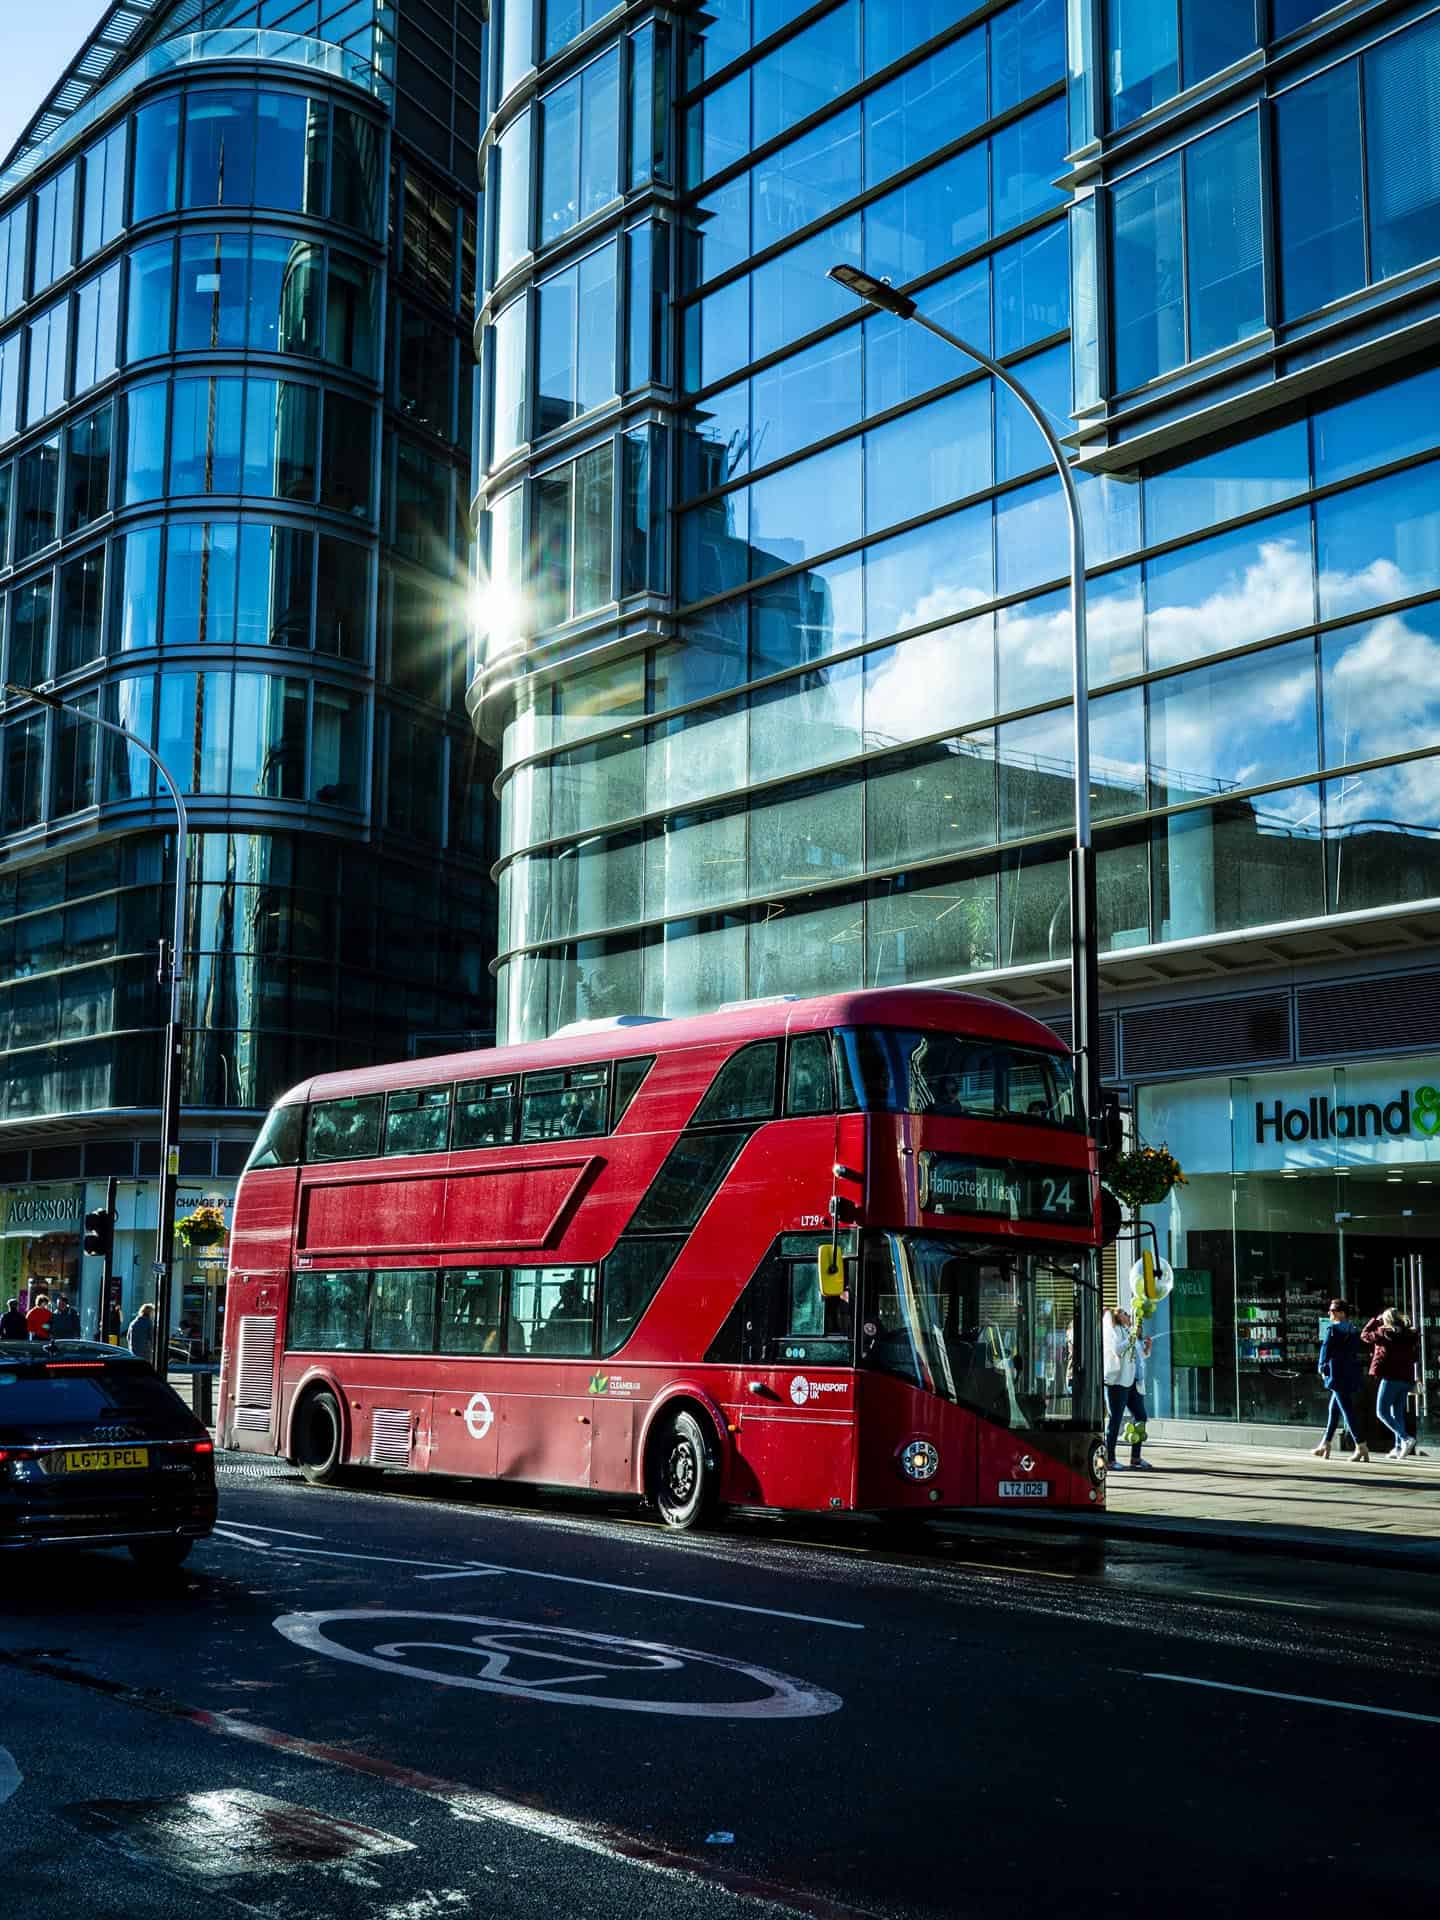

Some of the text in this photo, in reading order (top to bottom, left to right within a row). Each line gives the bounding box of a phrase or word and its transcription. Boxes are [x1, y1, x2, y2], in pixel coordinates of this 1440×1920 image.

[929, 1169, 988, 1200] Hampstead
[1042, 1178, 1074, 1213] 24
[218, 1198, 235, 1208] PLE
[8, 1198, 81, 1223] ACCESSORI
[809, 1382, 848, 1392] TRANSPORT
[810, 1390, 819, 1400] UK
[71, 1451, 142, 1468] LG73 PCL
[1004, 1483, 1043, 1495] LTZ 1029
[373, 1633, 684, 1687] 20
